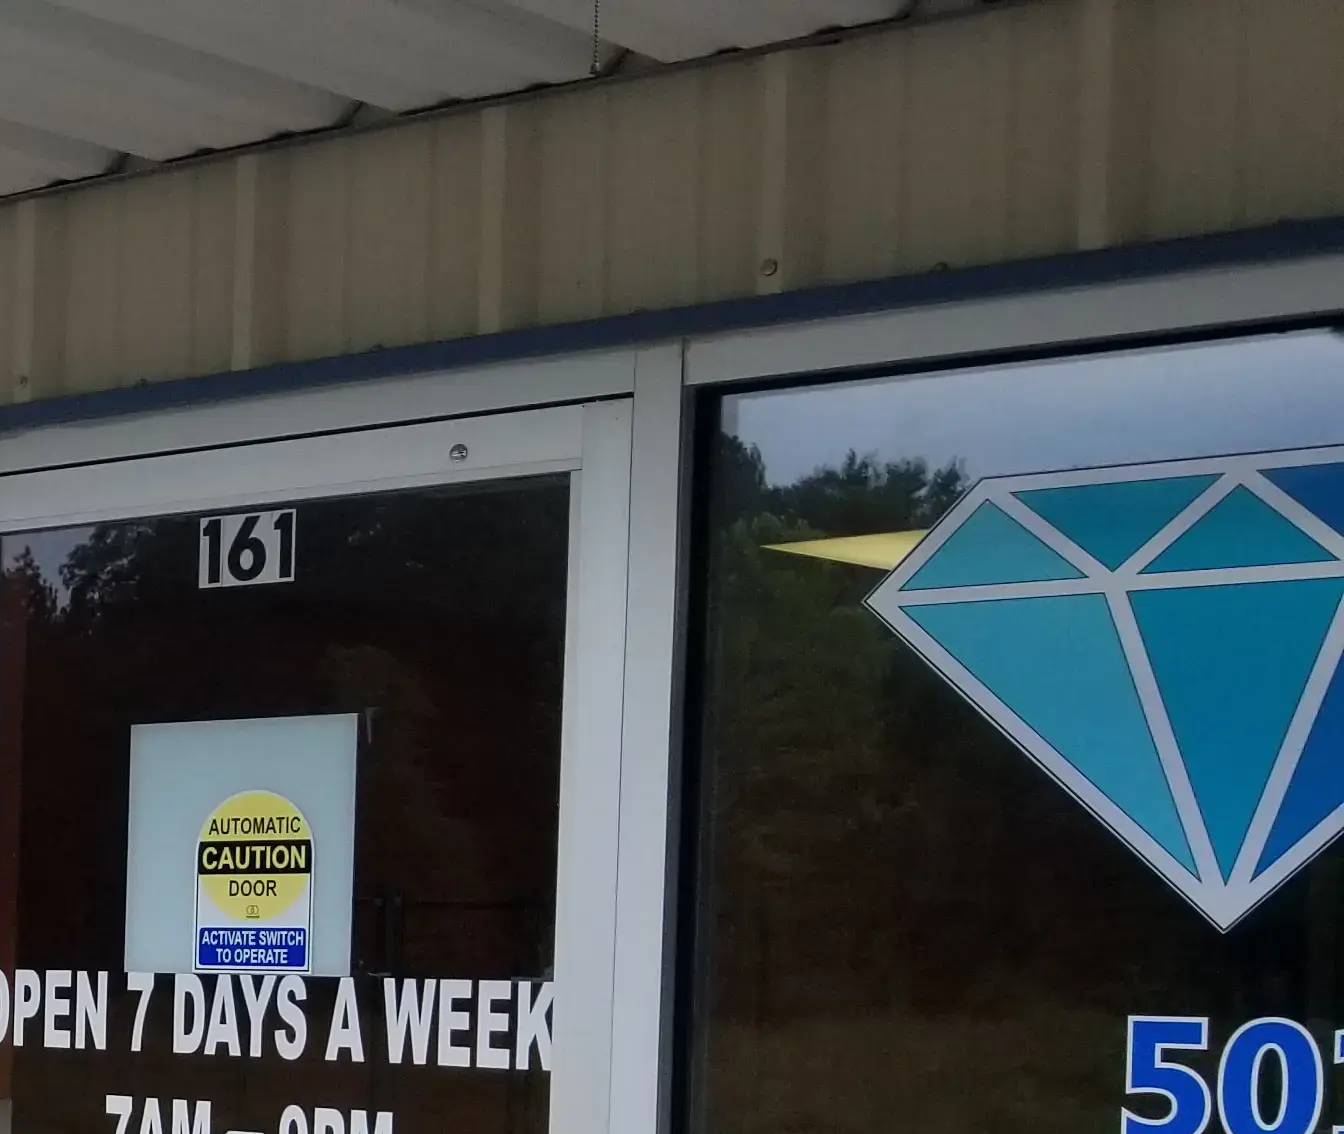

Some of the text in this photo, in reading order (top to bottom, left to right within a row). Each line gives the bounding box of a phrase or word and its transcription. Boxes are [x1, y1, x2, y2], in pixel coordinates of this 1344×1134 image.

[202, 512, 293, 584] 161
[208, 816, 301, 835] AUTOMATIC
[202, 845, 306, 870] CAUTION
[228, 880, 277, 897] DOOR
[201, 930, 304, 947] ACTIVATE SWITCH
[216, 948, 289, 964] TO OPERATE
[126, 970, 158, 1053] 7
[172, 973, 309, 1061] DAYS
[324, 976, 365, 1063] A
[384, 978, 555, 1072] WEEK
